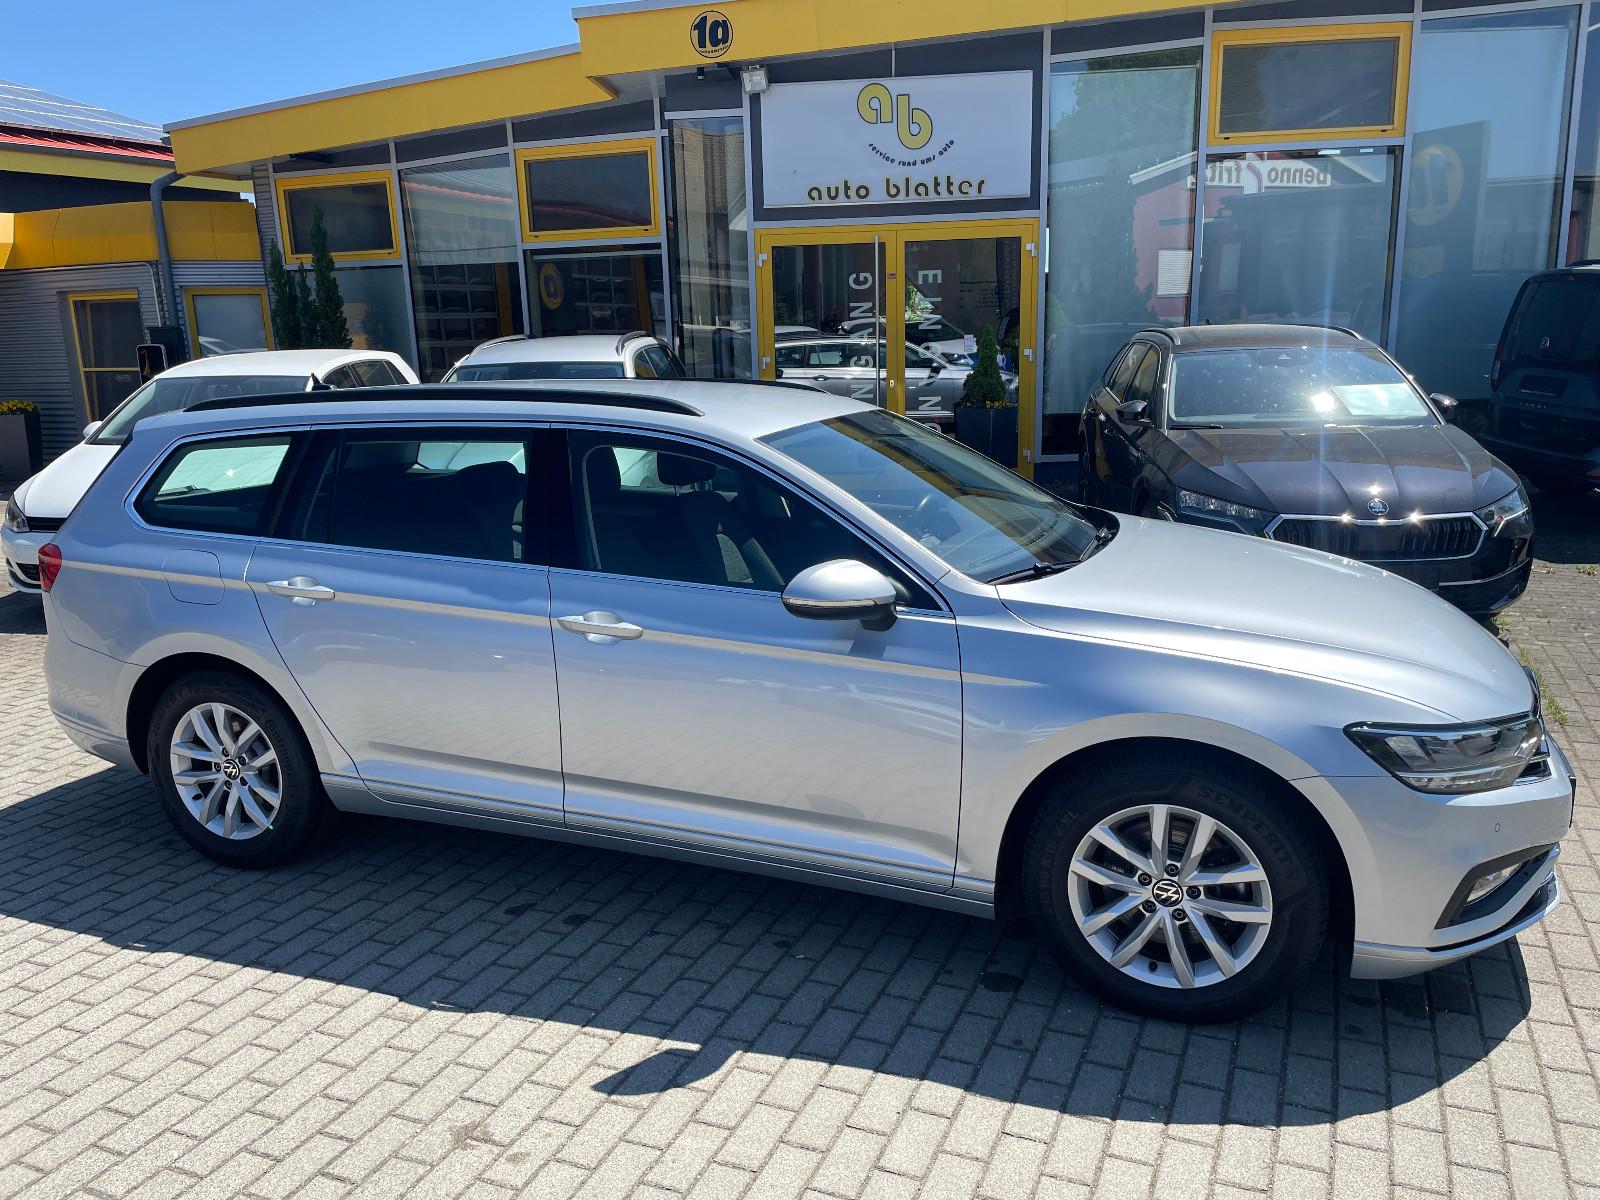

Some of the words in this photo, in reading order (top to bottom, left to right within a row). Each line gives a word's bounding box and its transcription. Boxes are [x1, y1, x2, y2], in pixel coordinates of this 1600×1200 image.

[693, 16, 729, 48] 1a
[857, 83, 933, 150] ab
[868, 143, 896, 164] service
[920, 154, 936, 165] ums
[938, 139, 955, 156] auto
[807, 180, 870, 200] auto
[885, 176, 985, 199] blatter
